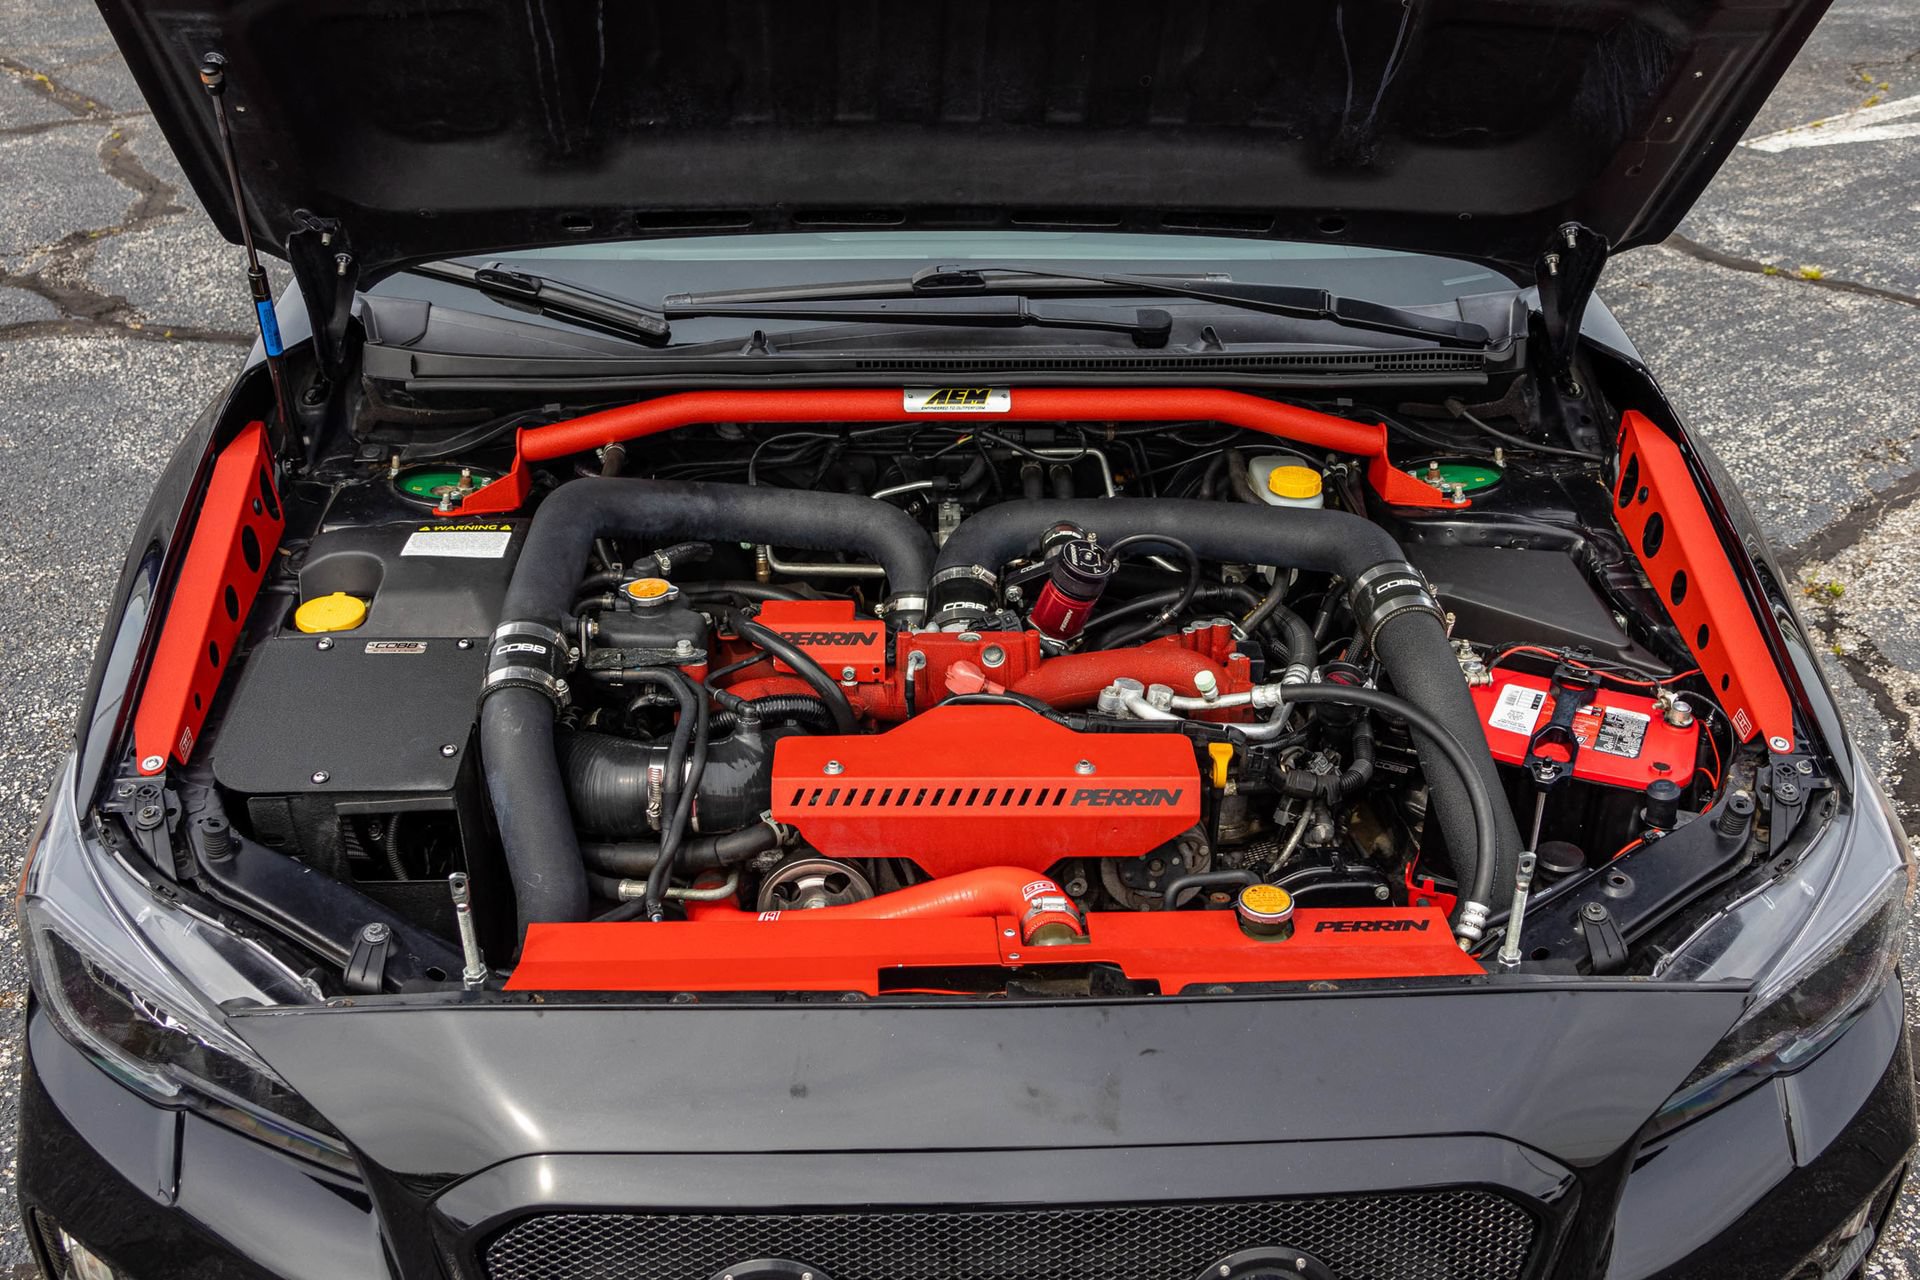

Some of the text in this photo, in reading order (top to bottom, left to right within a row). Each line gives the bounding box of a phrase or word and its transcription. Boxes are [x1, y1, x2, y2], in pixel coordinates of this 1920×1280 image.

[925, 388, 992, 405] AEM
[1376, 578, 1422, 595] COBB
[780, 631, 879, 646] PERRIN
[495, 643, 547, 655] COBB
[1070, 789, 1183, 806] PERRIN
[1314, 919, 1430, 933] PERRIN
